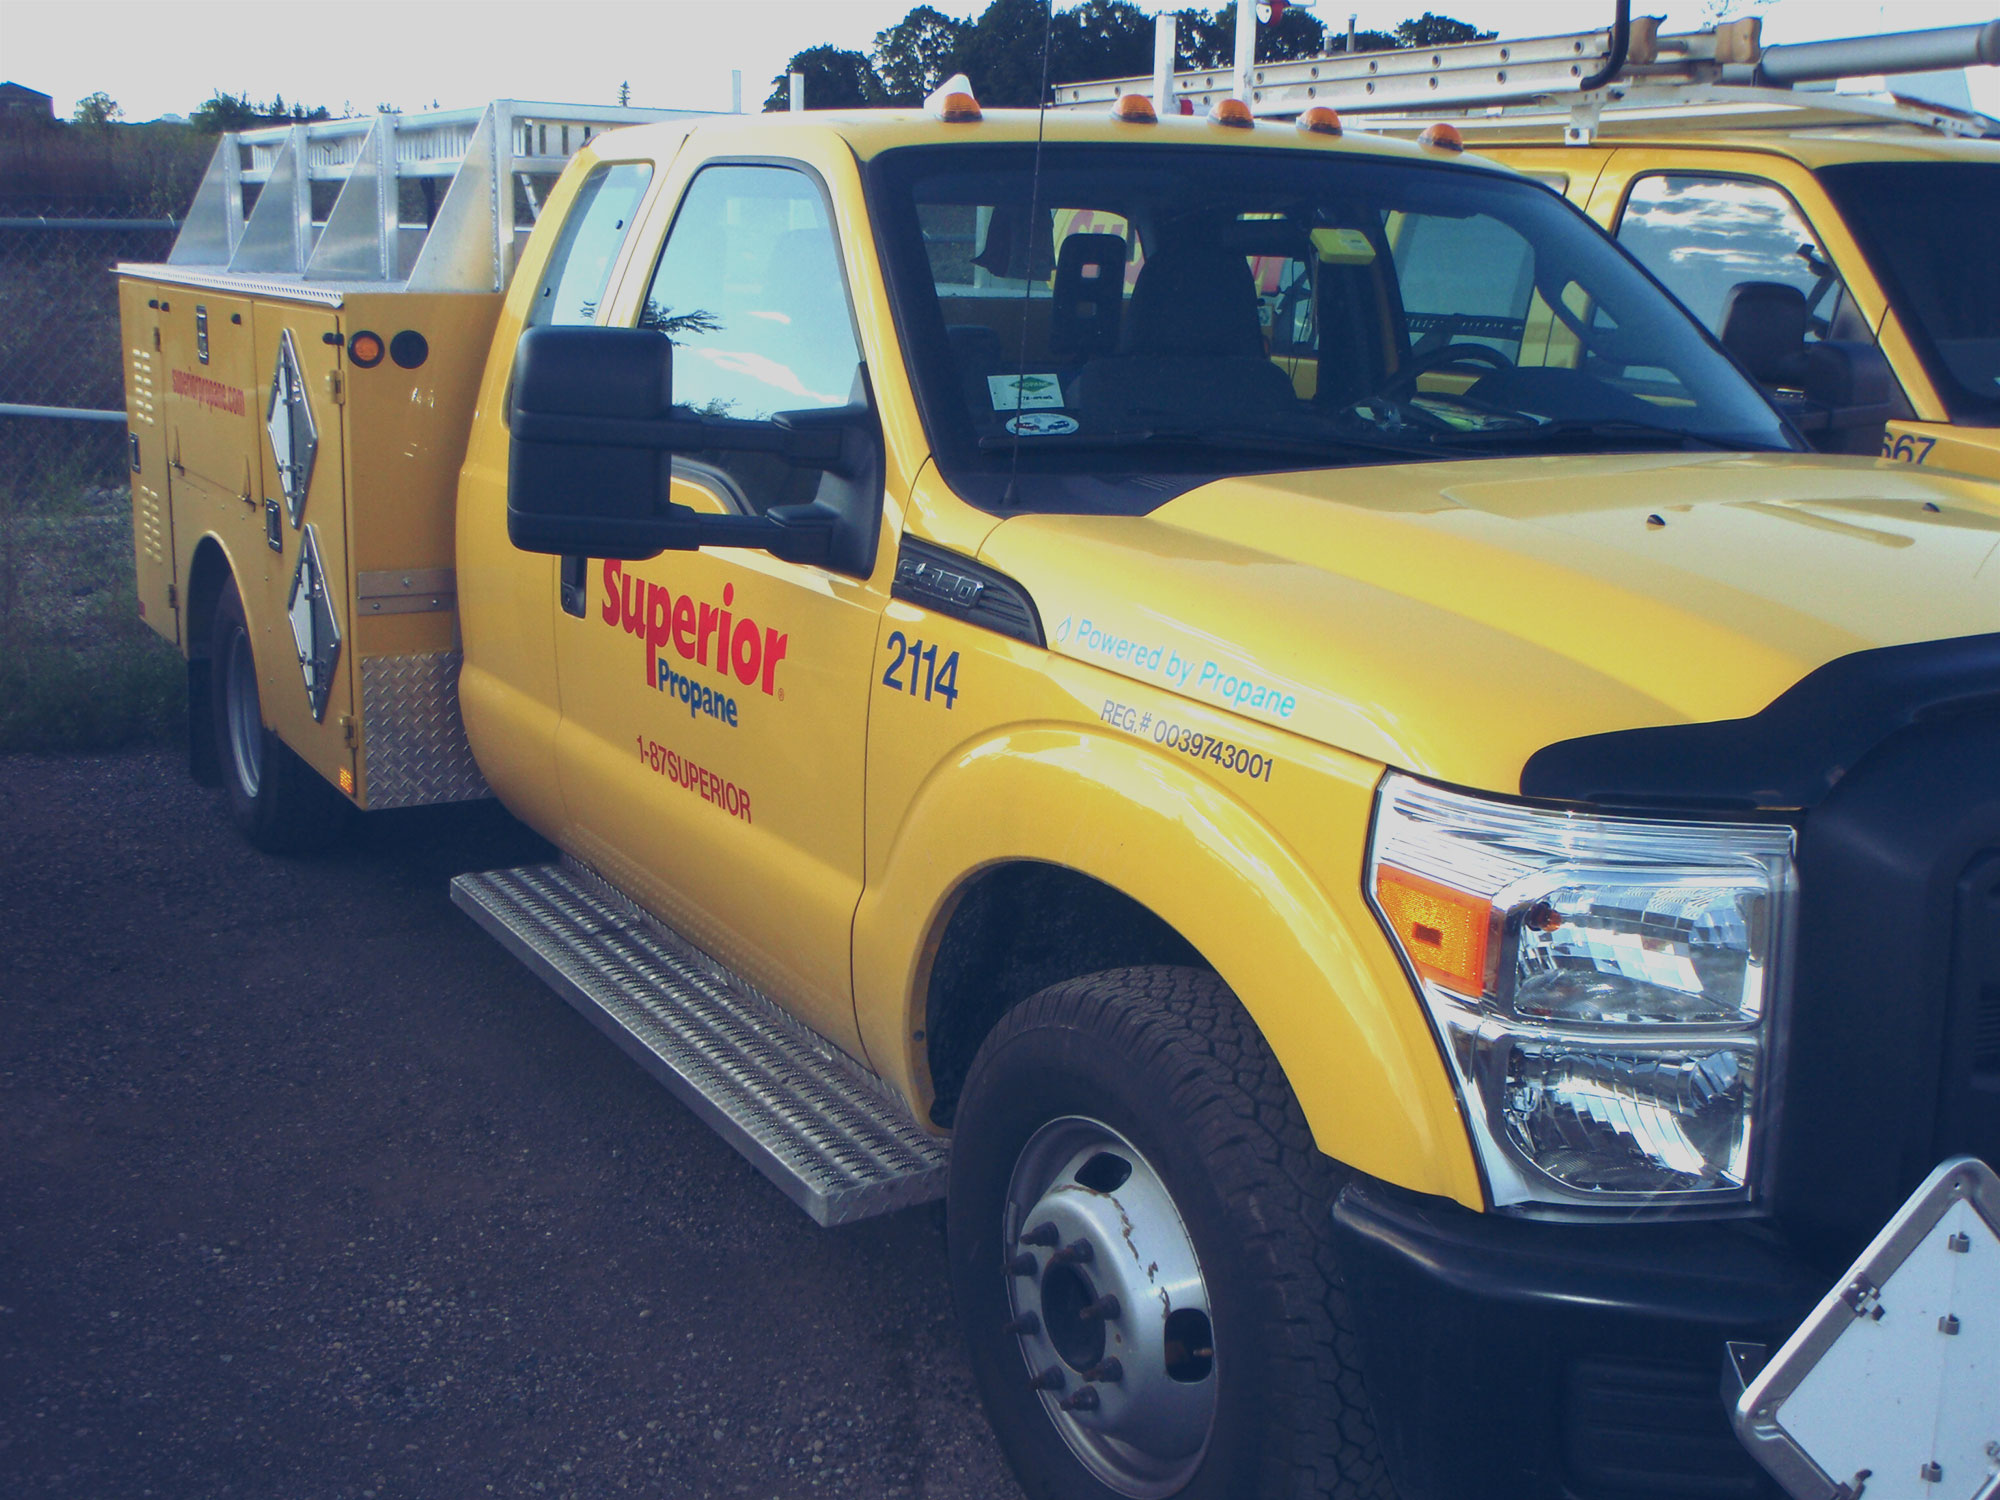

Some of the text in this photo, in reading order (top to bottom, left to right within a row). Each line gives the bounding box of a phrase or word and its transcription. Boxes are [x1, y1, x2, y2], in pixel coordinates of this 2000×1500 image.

[172, 366, 245, 416] superiorpropane.com
[602, 558, 788, 696] Superior
[658, 657, 738, 727] Propane
[882, 630, 960, 710] 2114
[1074, 619, 1297, 718] Powered by Propane
[636, 735, 751, 824] 1-87SUPERIOR
[1153, 719, 1273, 782] 0039743001
